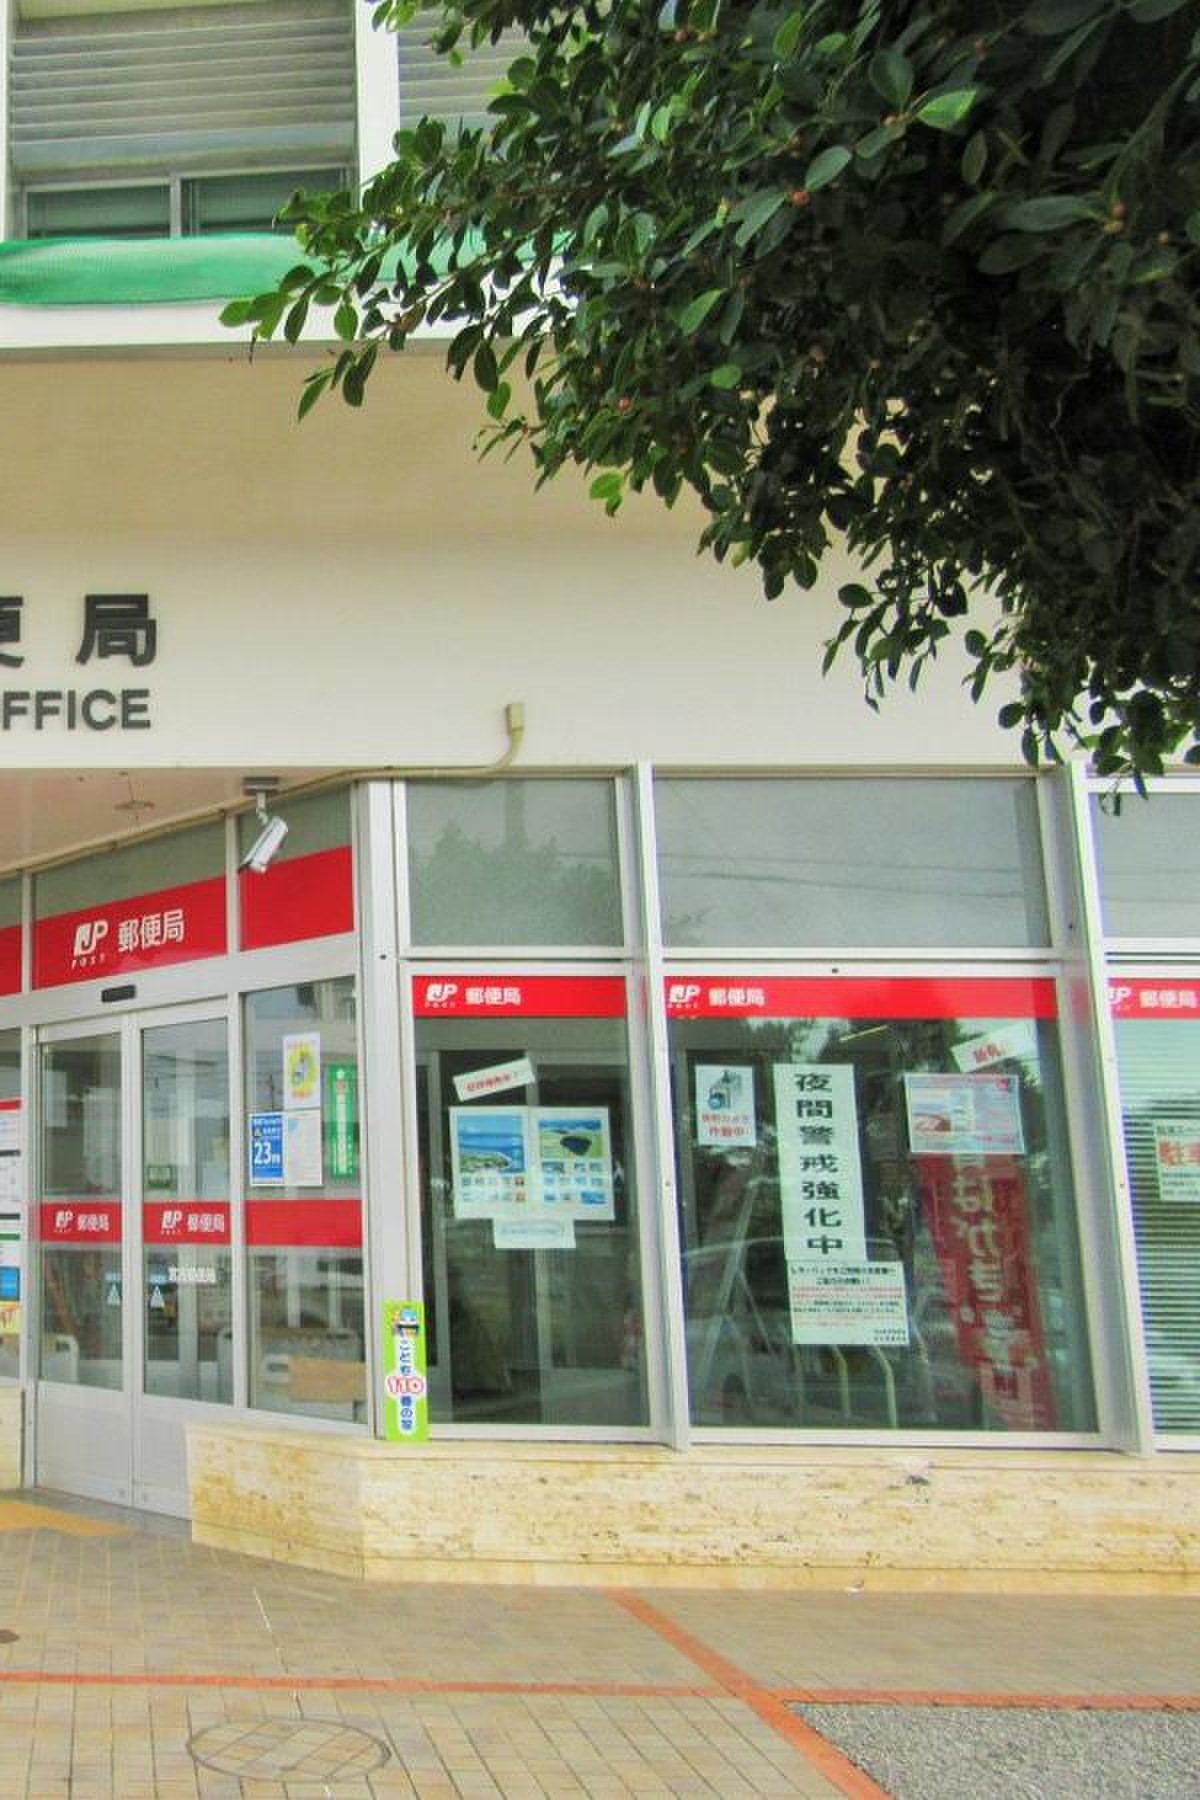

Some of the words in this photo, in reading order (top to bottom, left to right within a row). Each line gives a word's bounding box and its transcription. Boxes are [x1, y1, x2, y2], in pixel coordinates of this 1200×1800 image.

[117, 908, 185, 953] 郵便局
[465, 986, 521, 1006] 郵便局
[708, 987, 766, 1007] 郵便局
[1139, 989, 1197, 1009] 郵便局
[794, 1073, 845, 1255] 夜間警戒強化中
